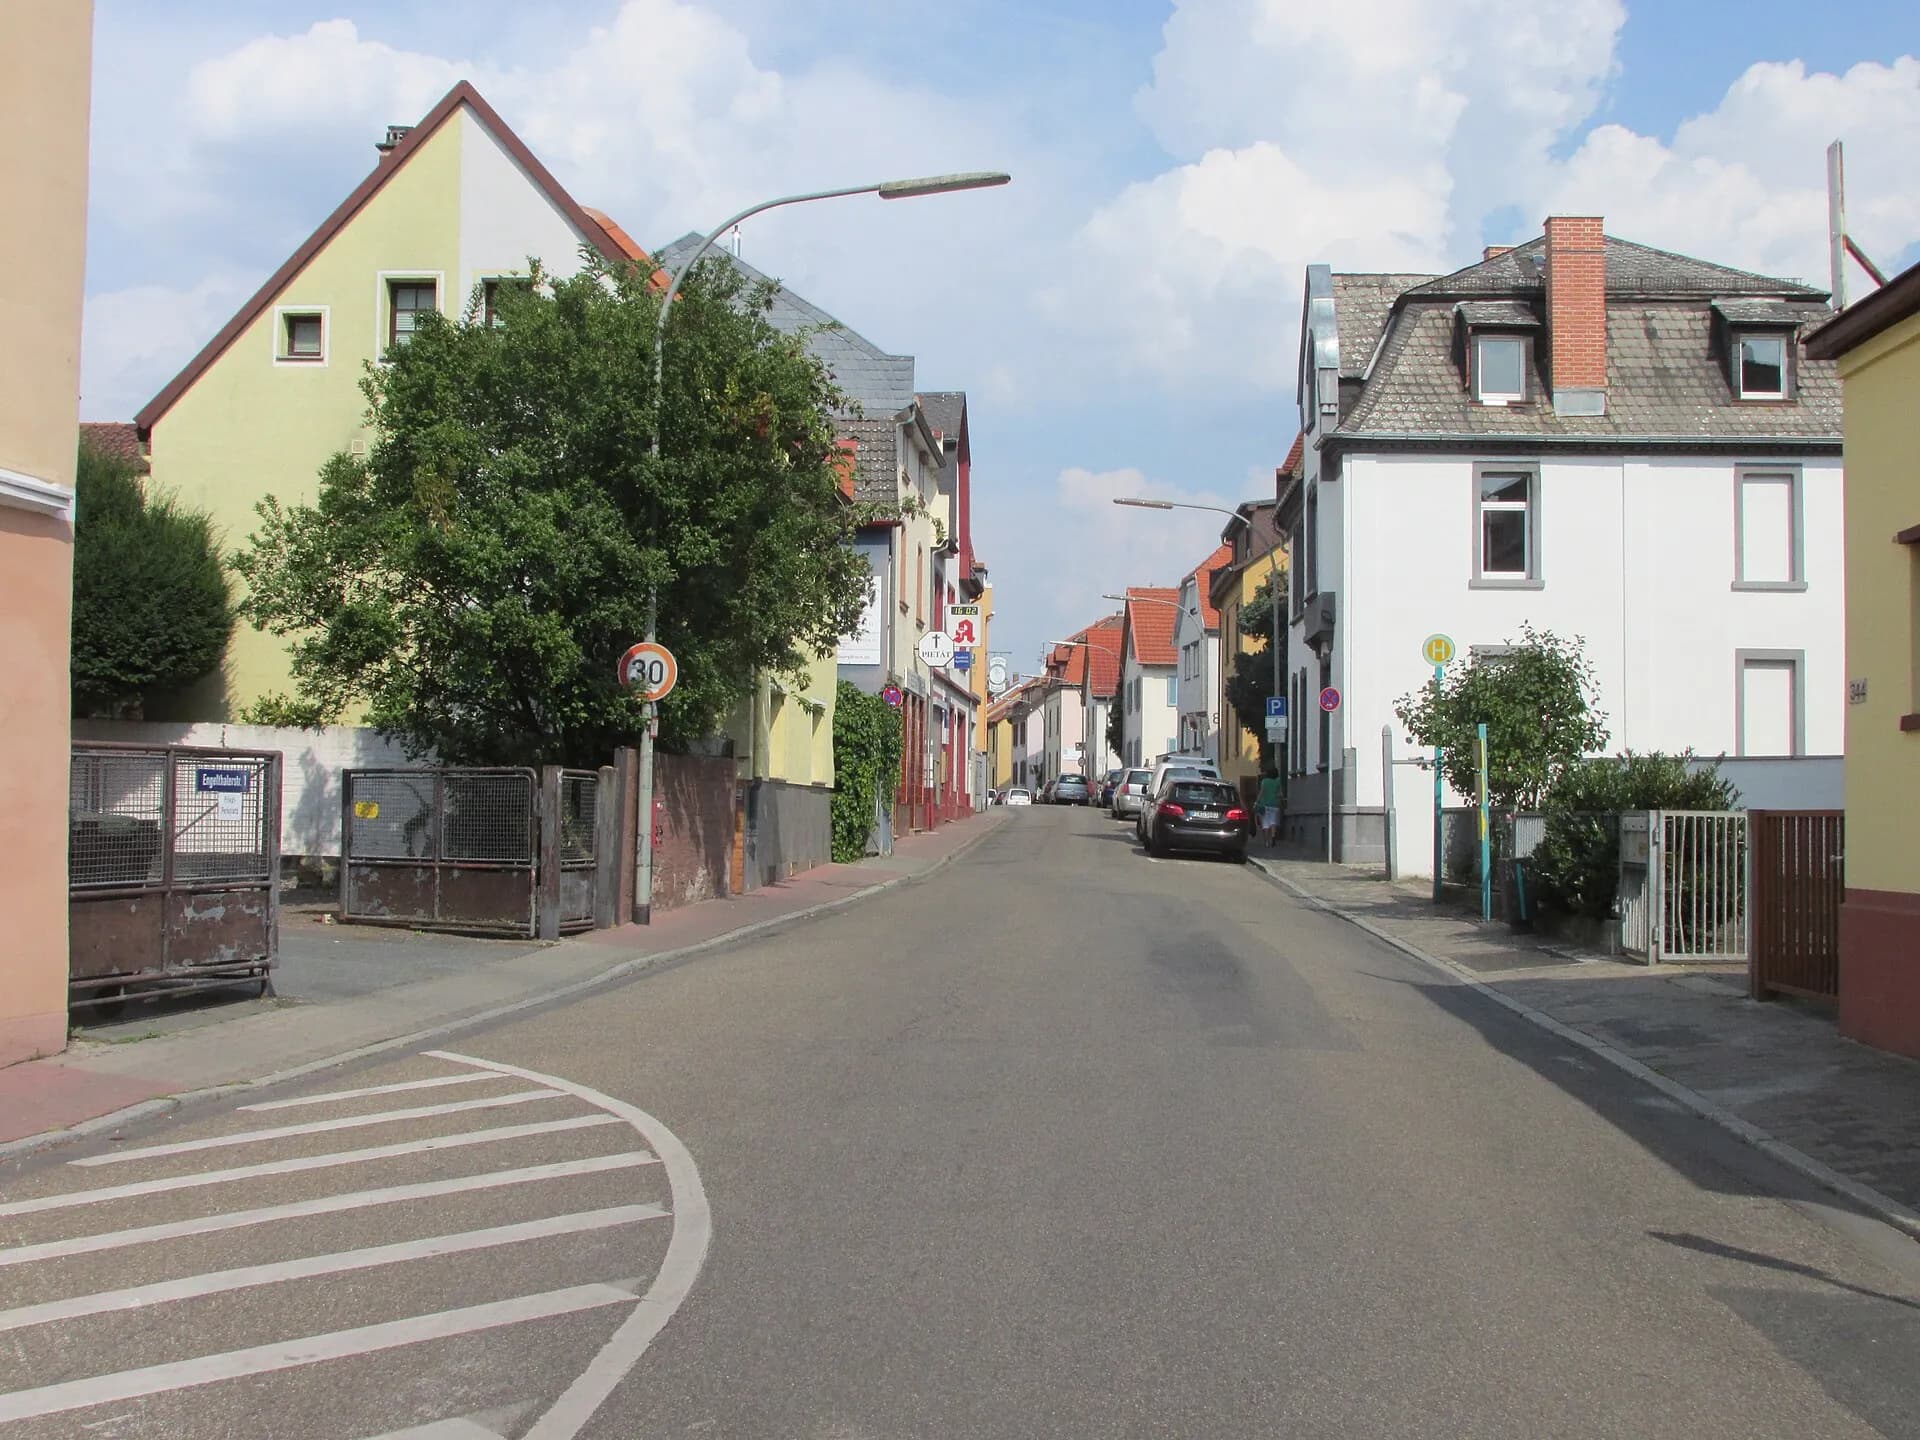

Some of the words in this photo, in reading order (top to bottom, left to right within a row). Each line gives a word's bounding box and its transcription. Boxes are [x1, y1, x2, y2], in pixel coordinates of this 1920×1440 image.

[954, 619, 975, 643] A
[1432, 641, 1445, 659] H
[631, 658, 663, 685] 30
[1271, 699, 1281, 714] P
